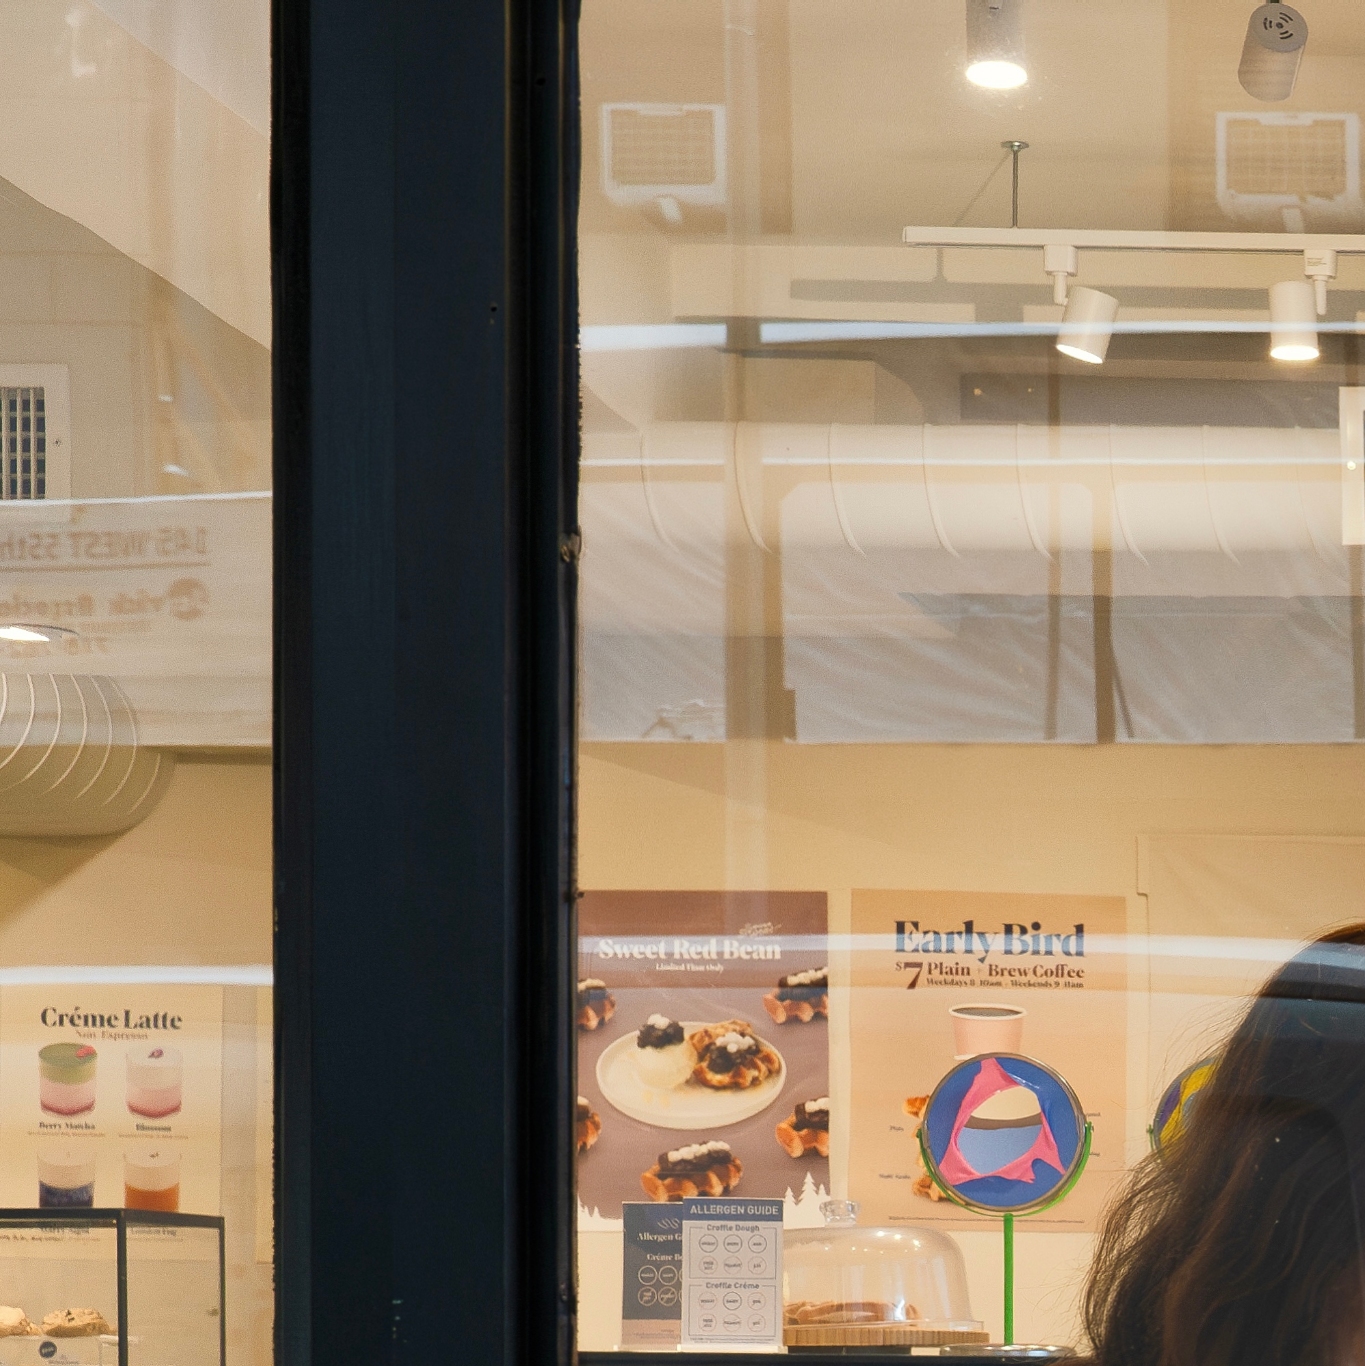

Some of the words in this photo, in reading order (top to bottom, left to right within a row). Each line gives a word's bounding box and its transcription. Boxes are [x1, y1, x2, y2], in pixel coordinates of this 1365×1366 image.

[598, 938, 666, 960] Sweet
[673, 938, 718, 960] Red
[723, 939, 781, 960] Bean
[894, 920, 999, 964] Early
[1001, 921, 1085, 957] Bird
[895, 961, 923, 990] $7
[928, 962, 971, 976] Plain
[988, 963, 1032, 978] Brew
[1033, 963, 1085, 979] Coffee
[927, 977, 968, 988] Weekdays
[1011, 979, 1053, 988] Weekends
[123, 1009, 183, 1030] Latte
[690, 1204, 745, 1215] ALLERGEN
[748, 1205, 779, 1215] GUIDE
[706, 1224, 733, 1232] Croffle
[735, 1224, 760, 1233] Dough
[637, 1233, 673, 1242] Allergen
